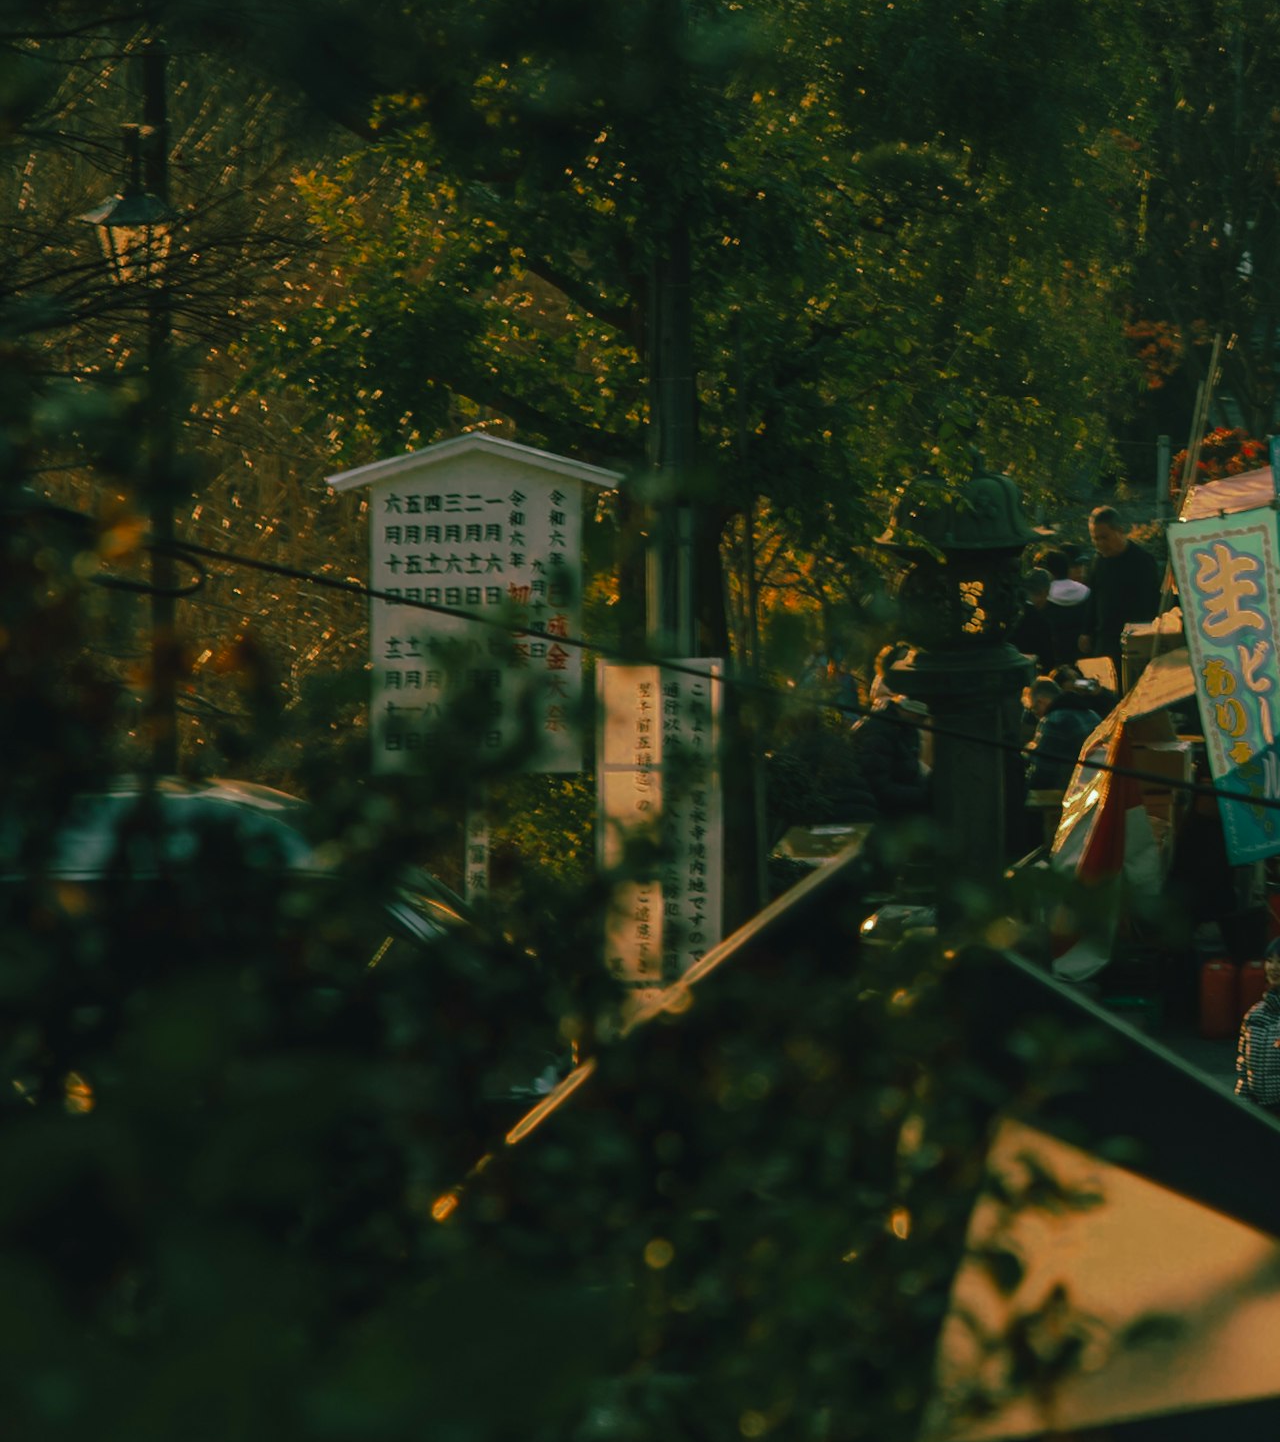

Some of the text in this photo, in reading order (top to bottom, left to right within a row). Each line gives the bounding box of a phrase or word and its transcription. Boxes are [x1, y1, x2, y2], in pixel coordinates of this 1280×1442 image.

[384, 494, 403, 605] 六月十日
[405, 495, 423, 605] 五月五日
[445, 494, 464, 605] 三月六日
[486, 497, 504, 604] 一月六日
[508, 490, 527, 568] 令和六年
[549, 489, 567, 567] 令和六年
